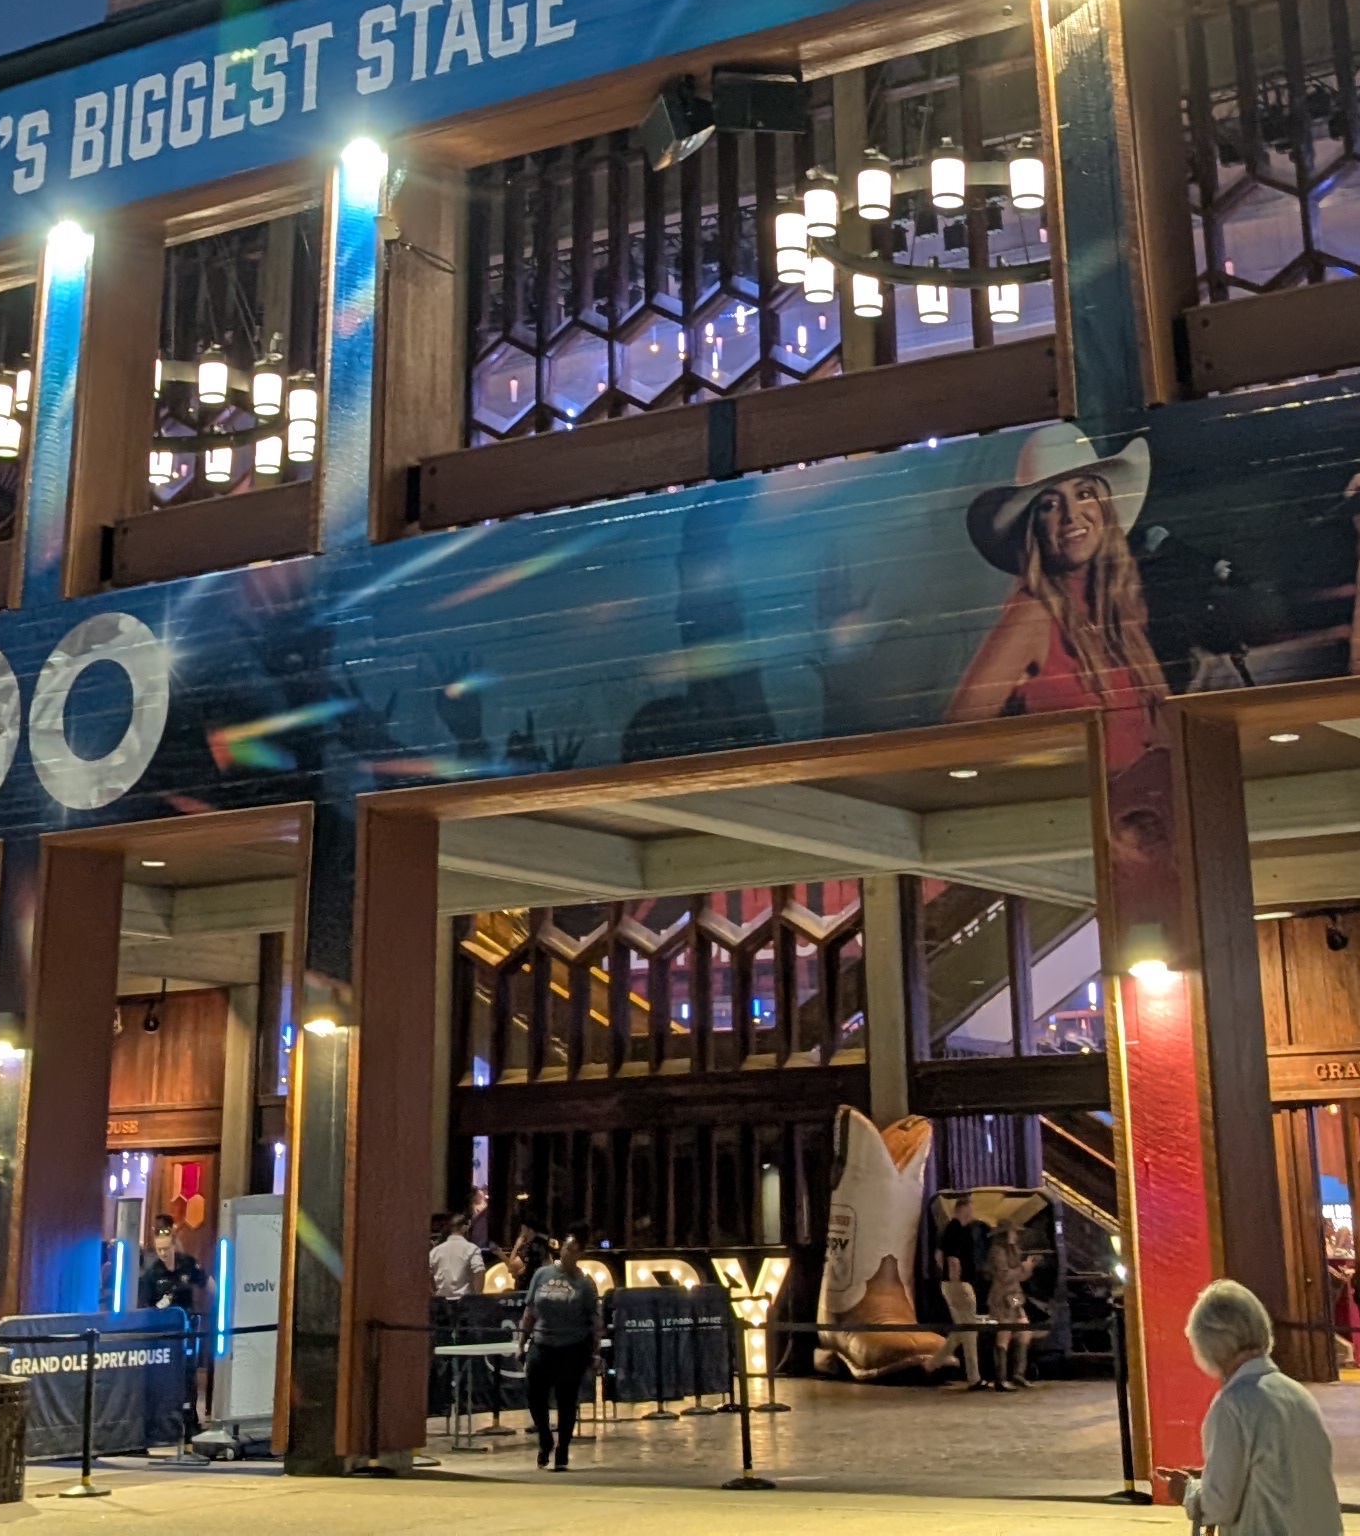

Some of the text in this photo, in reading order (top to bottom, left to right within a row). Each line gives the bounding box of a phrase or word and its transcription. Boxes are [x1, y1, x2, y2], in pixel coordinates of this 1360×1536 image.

[68, 21, 334, 180] BIGGEST
[243, 1279, 277, 1293] evolv
[11, 1356, 60, 1375] GRAND
[61, 1353, 88, 1372] OLE
[128, 1348, 171, 1367] HOUSE
